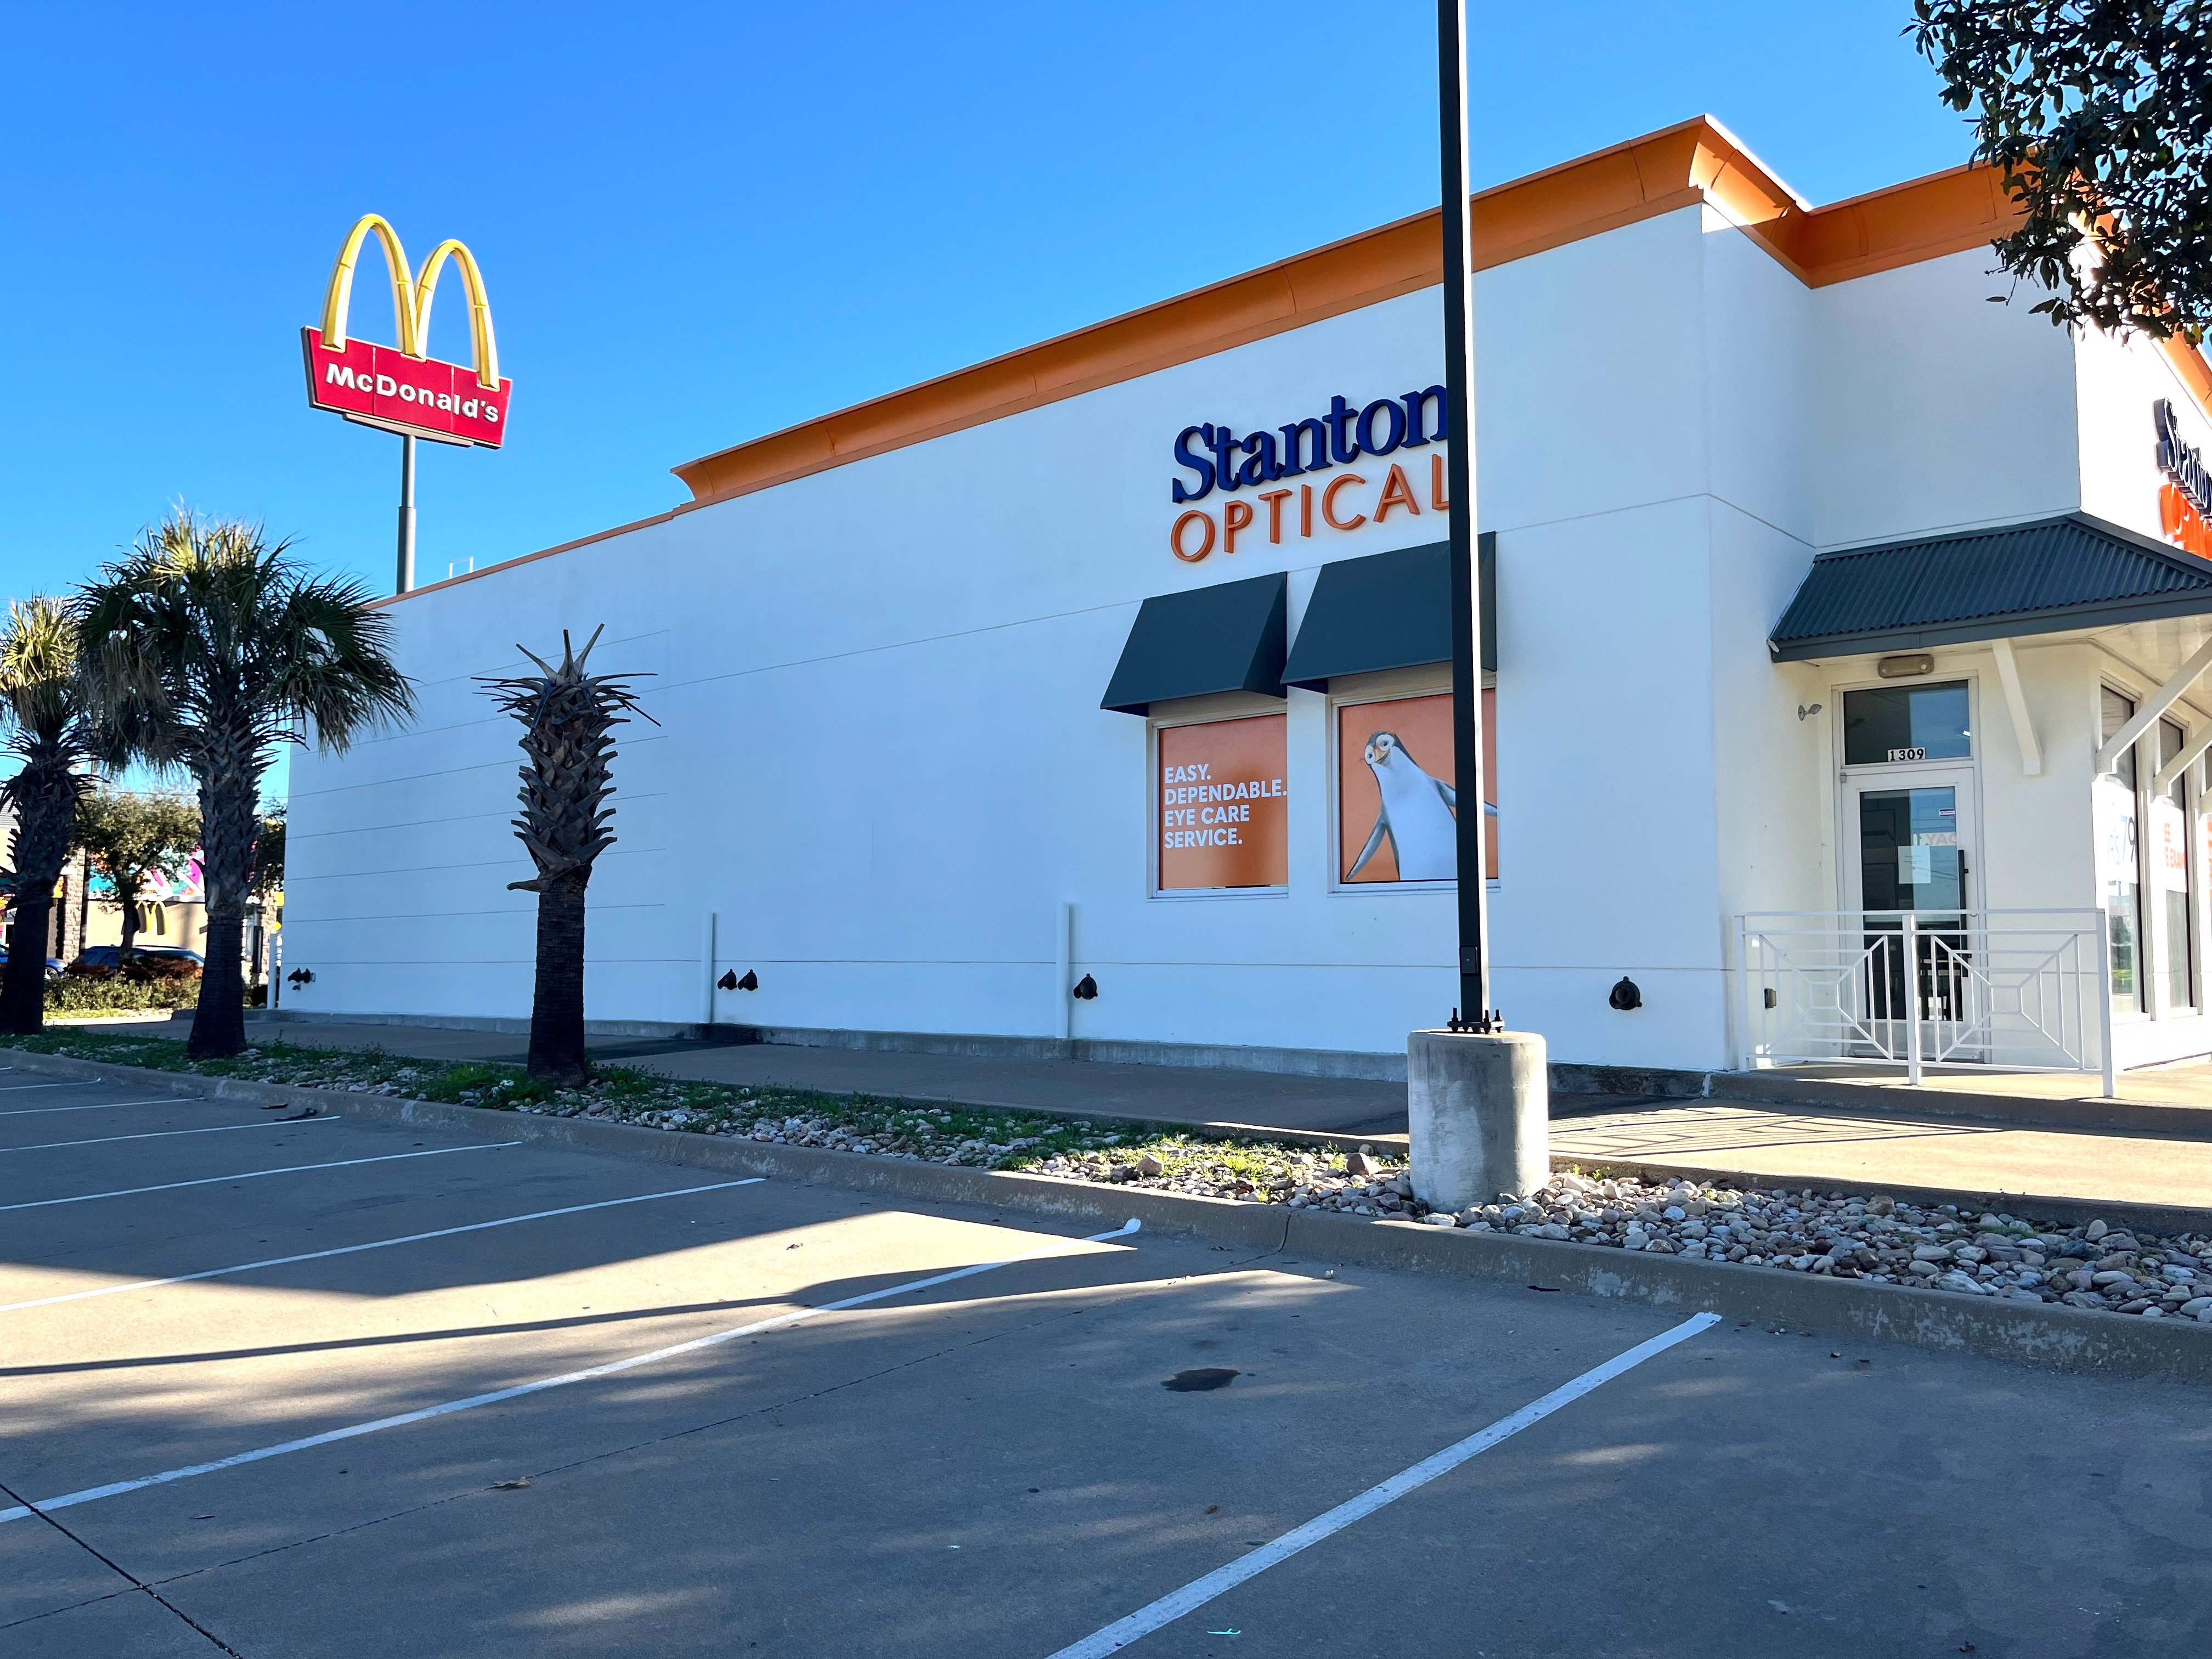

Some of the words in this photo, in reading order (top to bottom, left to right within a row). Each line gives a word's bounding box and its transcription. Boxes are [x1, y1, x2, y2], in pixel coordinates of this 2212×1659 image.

[325, 363, 499, 423] McDonald's
[1172, 385, 1447, 504] Stanton
[1170, 454, 1450, 563] OPTICAL
[1890, 748, 1924, 761] 1309
[1165, 764, 1211, 783] EASY.
[1165, 779, 1287, 805] DEPENDABLE.
[1165, 809, 1195, 827] EYE
[1201, 804, 1250, 824] CARE
[1164, 827, 1243, 849] SERVICE.
